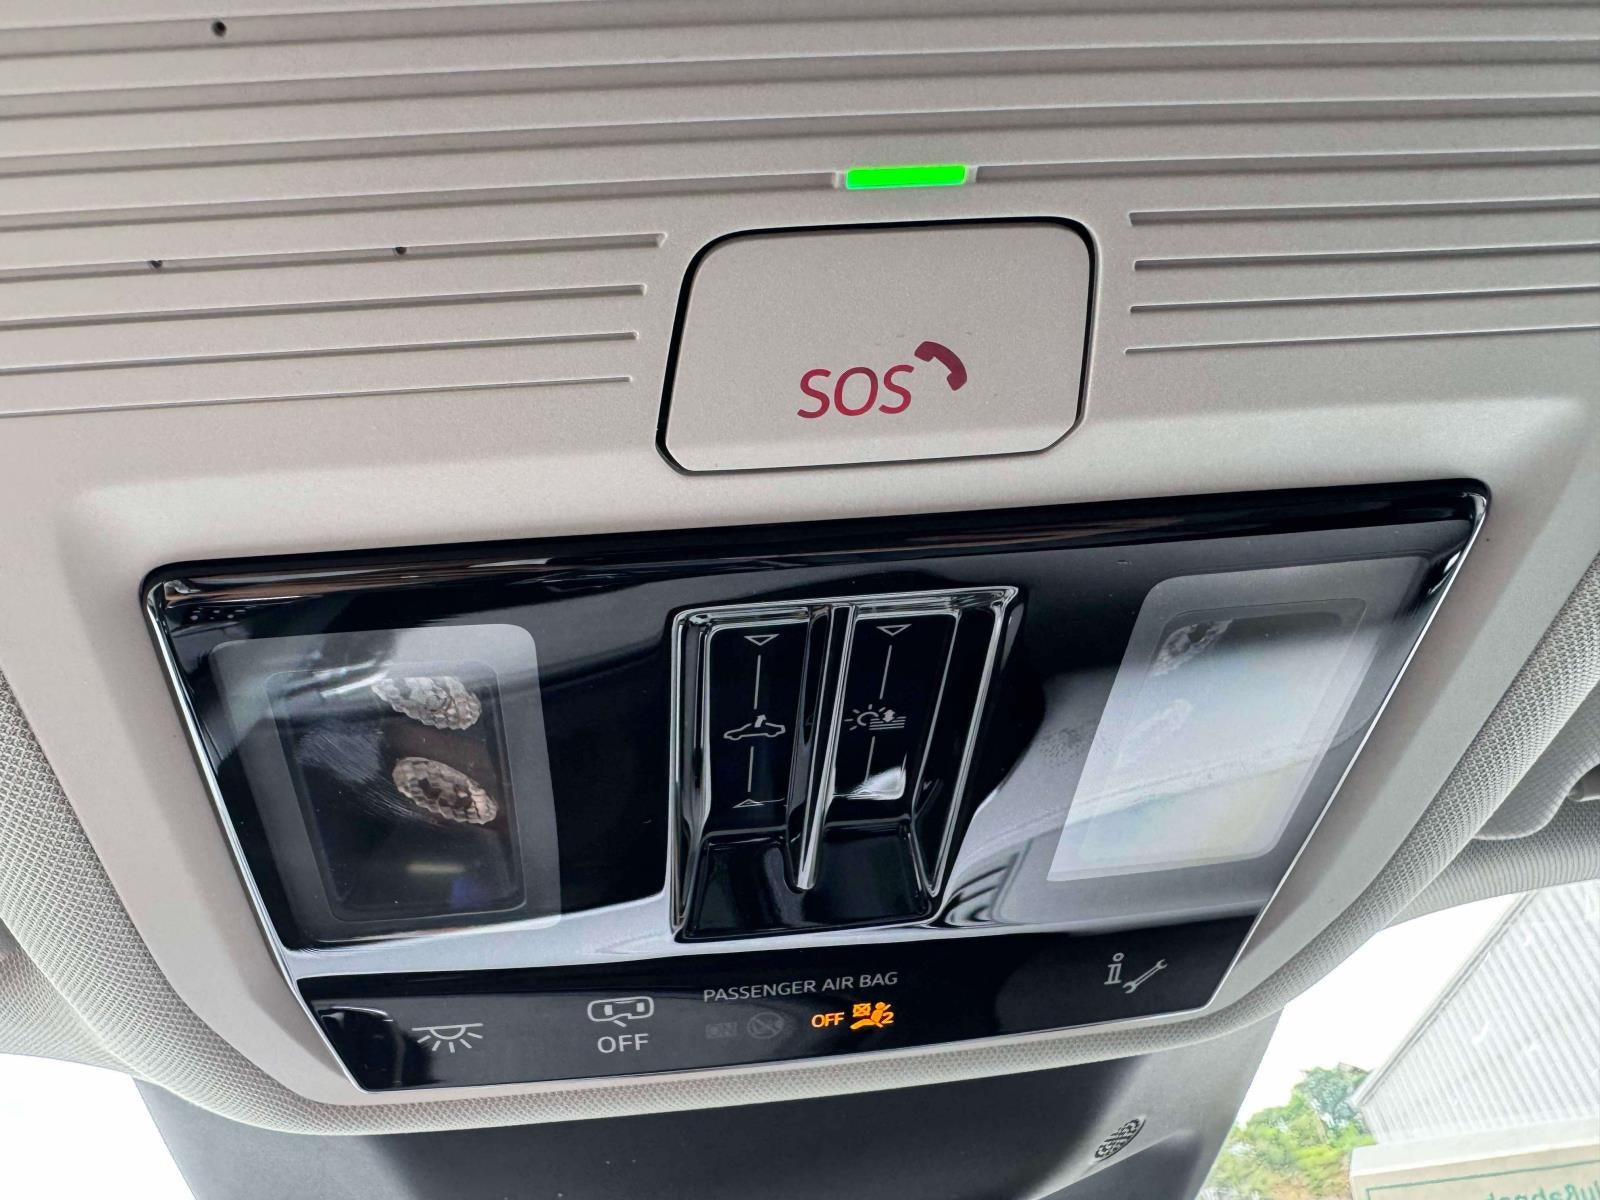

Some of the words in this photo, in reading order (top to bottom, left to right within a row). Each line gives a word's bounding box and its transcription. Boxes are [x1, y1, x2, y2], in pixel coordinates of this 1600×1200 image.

[796, 364, 915, 419] SOS
[703, 979, 816, 1002] PASSENGER
[821, 975, 853, 992] AIR
[858, 971, 898, 988] BAG
[811, 1011, 845, 1028] OFF
[597, 1033, 649, 1053] OFF
